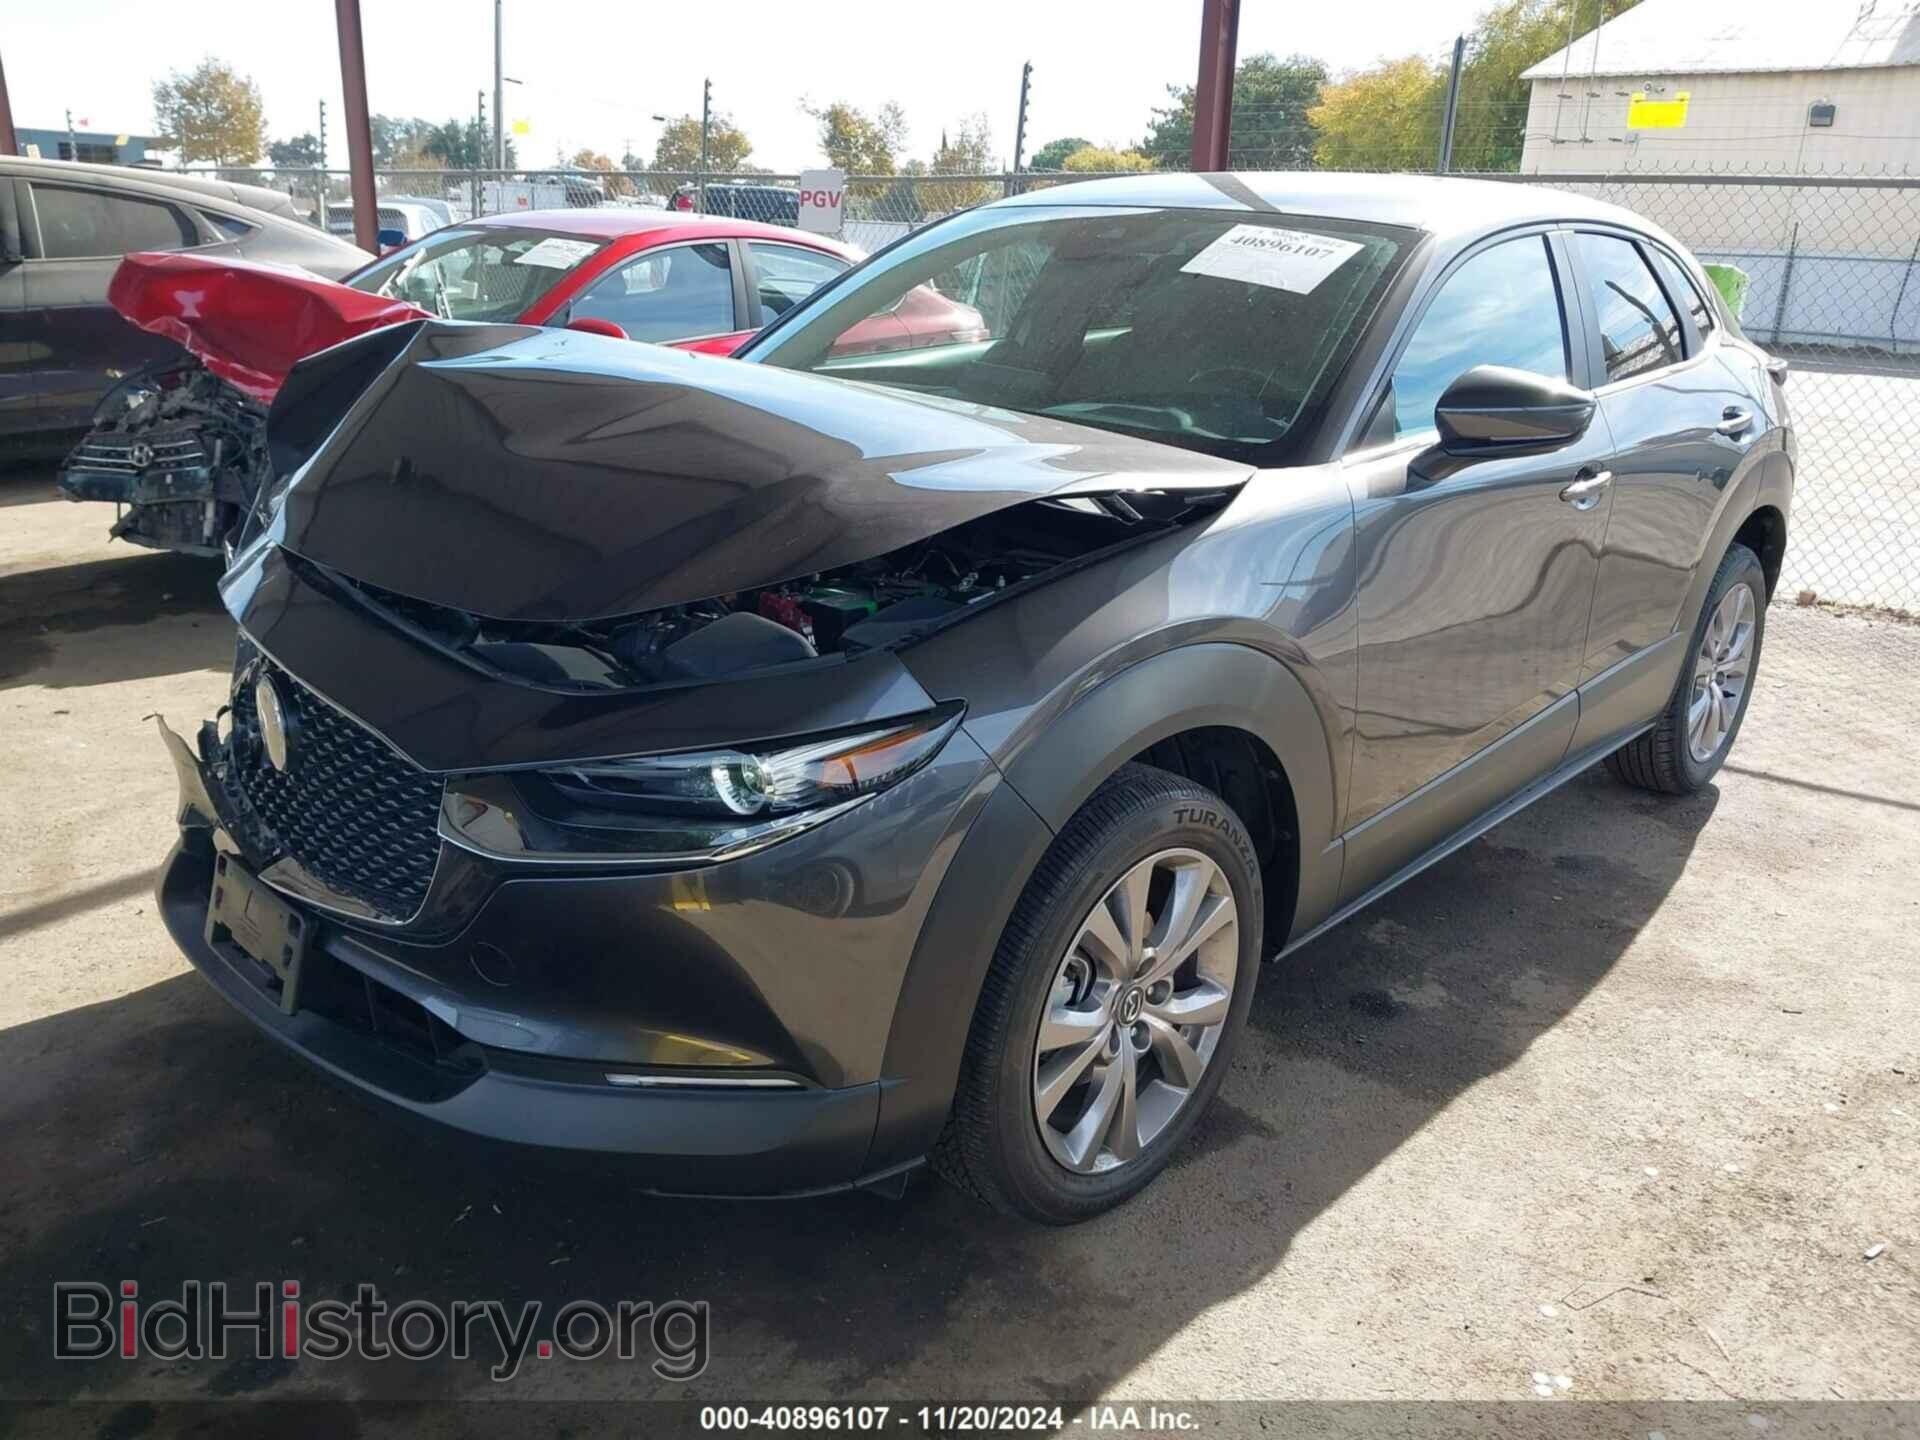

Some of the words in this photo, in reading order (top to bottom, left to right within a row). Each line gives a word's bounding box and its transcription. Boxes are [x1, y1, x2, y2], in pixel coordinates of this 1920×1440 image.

[800, 190, 841, 208] PGV
[1231, 235, 1335, 258] 40896107
[1173, 808, 1256, 878] TURANZA
